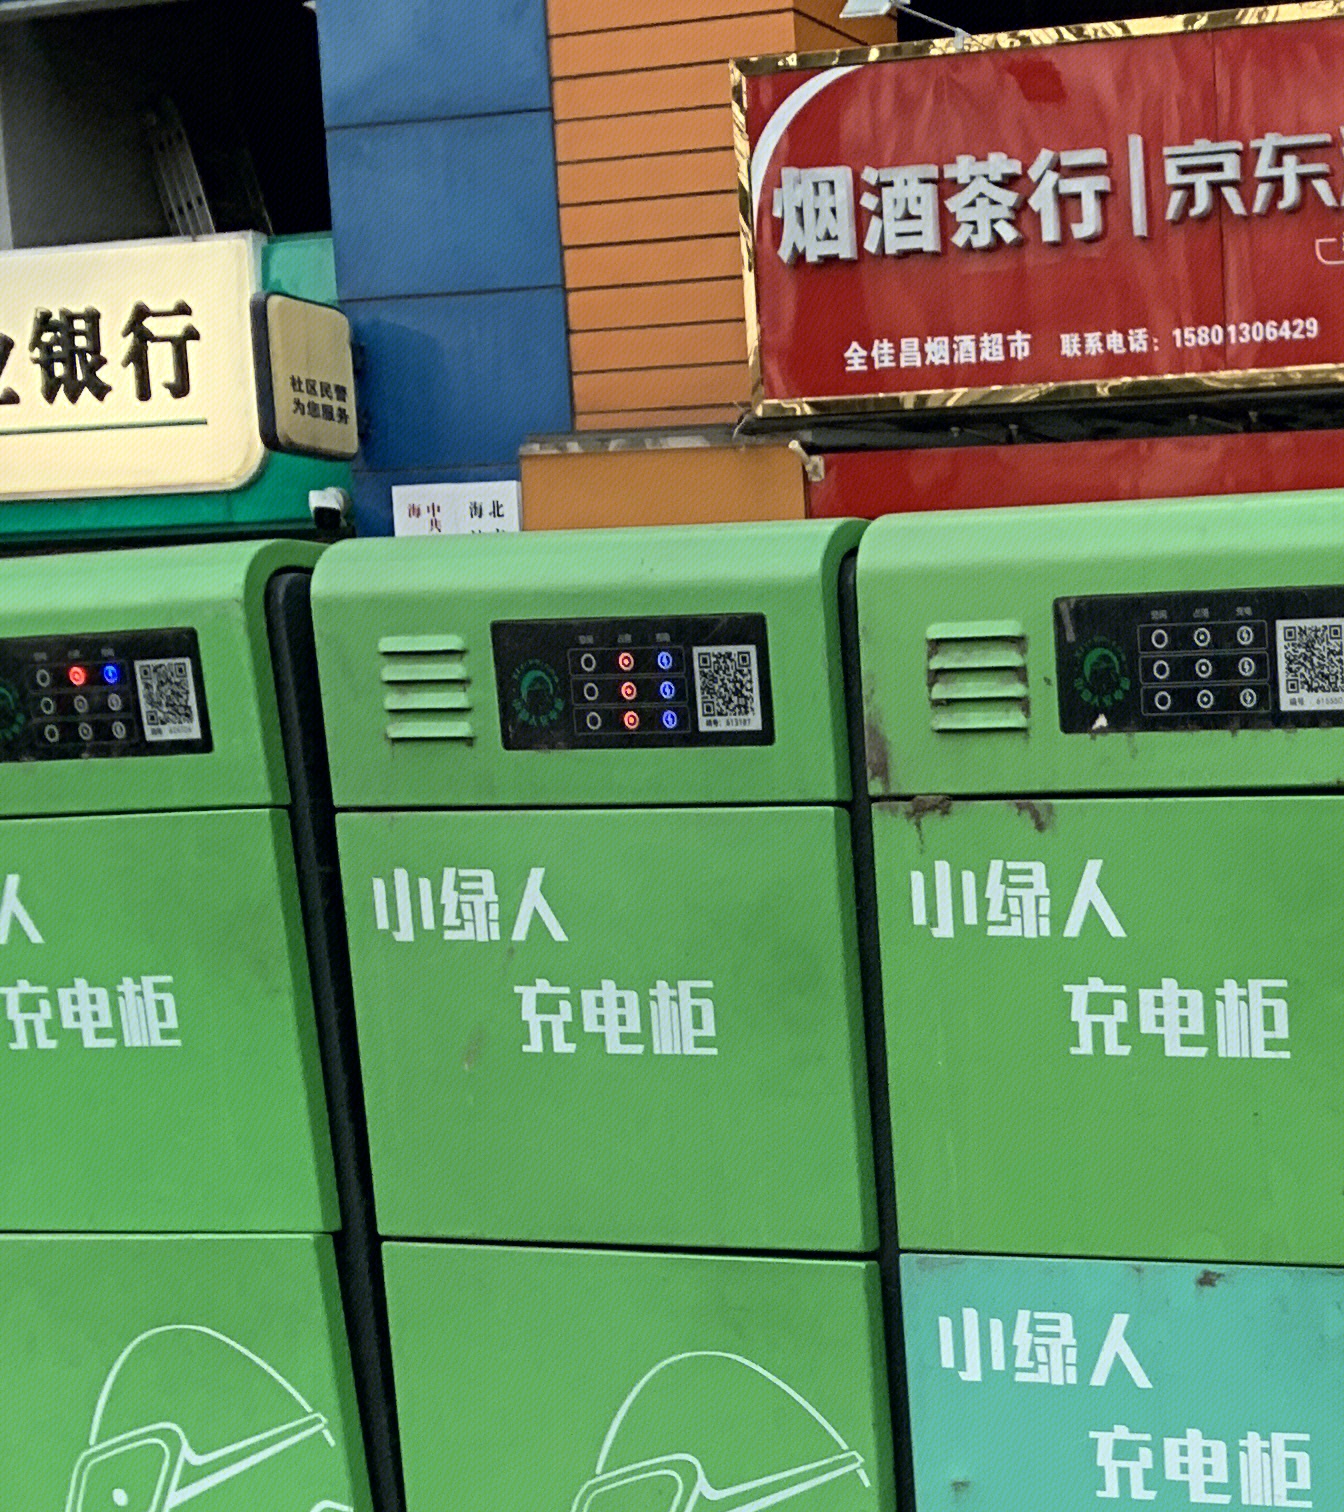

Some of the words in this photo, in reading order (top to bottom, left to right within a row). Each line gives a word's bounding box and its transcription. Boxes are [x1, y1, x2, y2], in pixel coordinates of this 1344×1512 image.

[842, 330, 1033, 372] 全佳昌烟酒超市
[372, 867, 569, 942] 小绿人
[910, 859, 1127, 938] 小绿人
[0, 975, 182, 1049] 充电柜
[514, 978, 719, 1055] 充电柜
[1063, 977, 1292, 1059] 充电柜
[938, 1307, 1154, 1389] 小绿人
[1088, 1424, 1314, 1509] 充电柜
